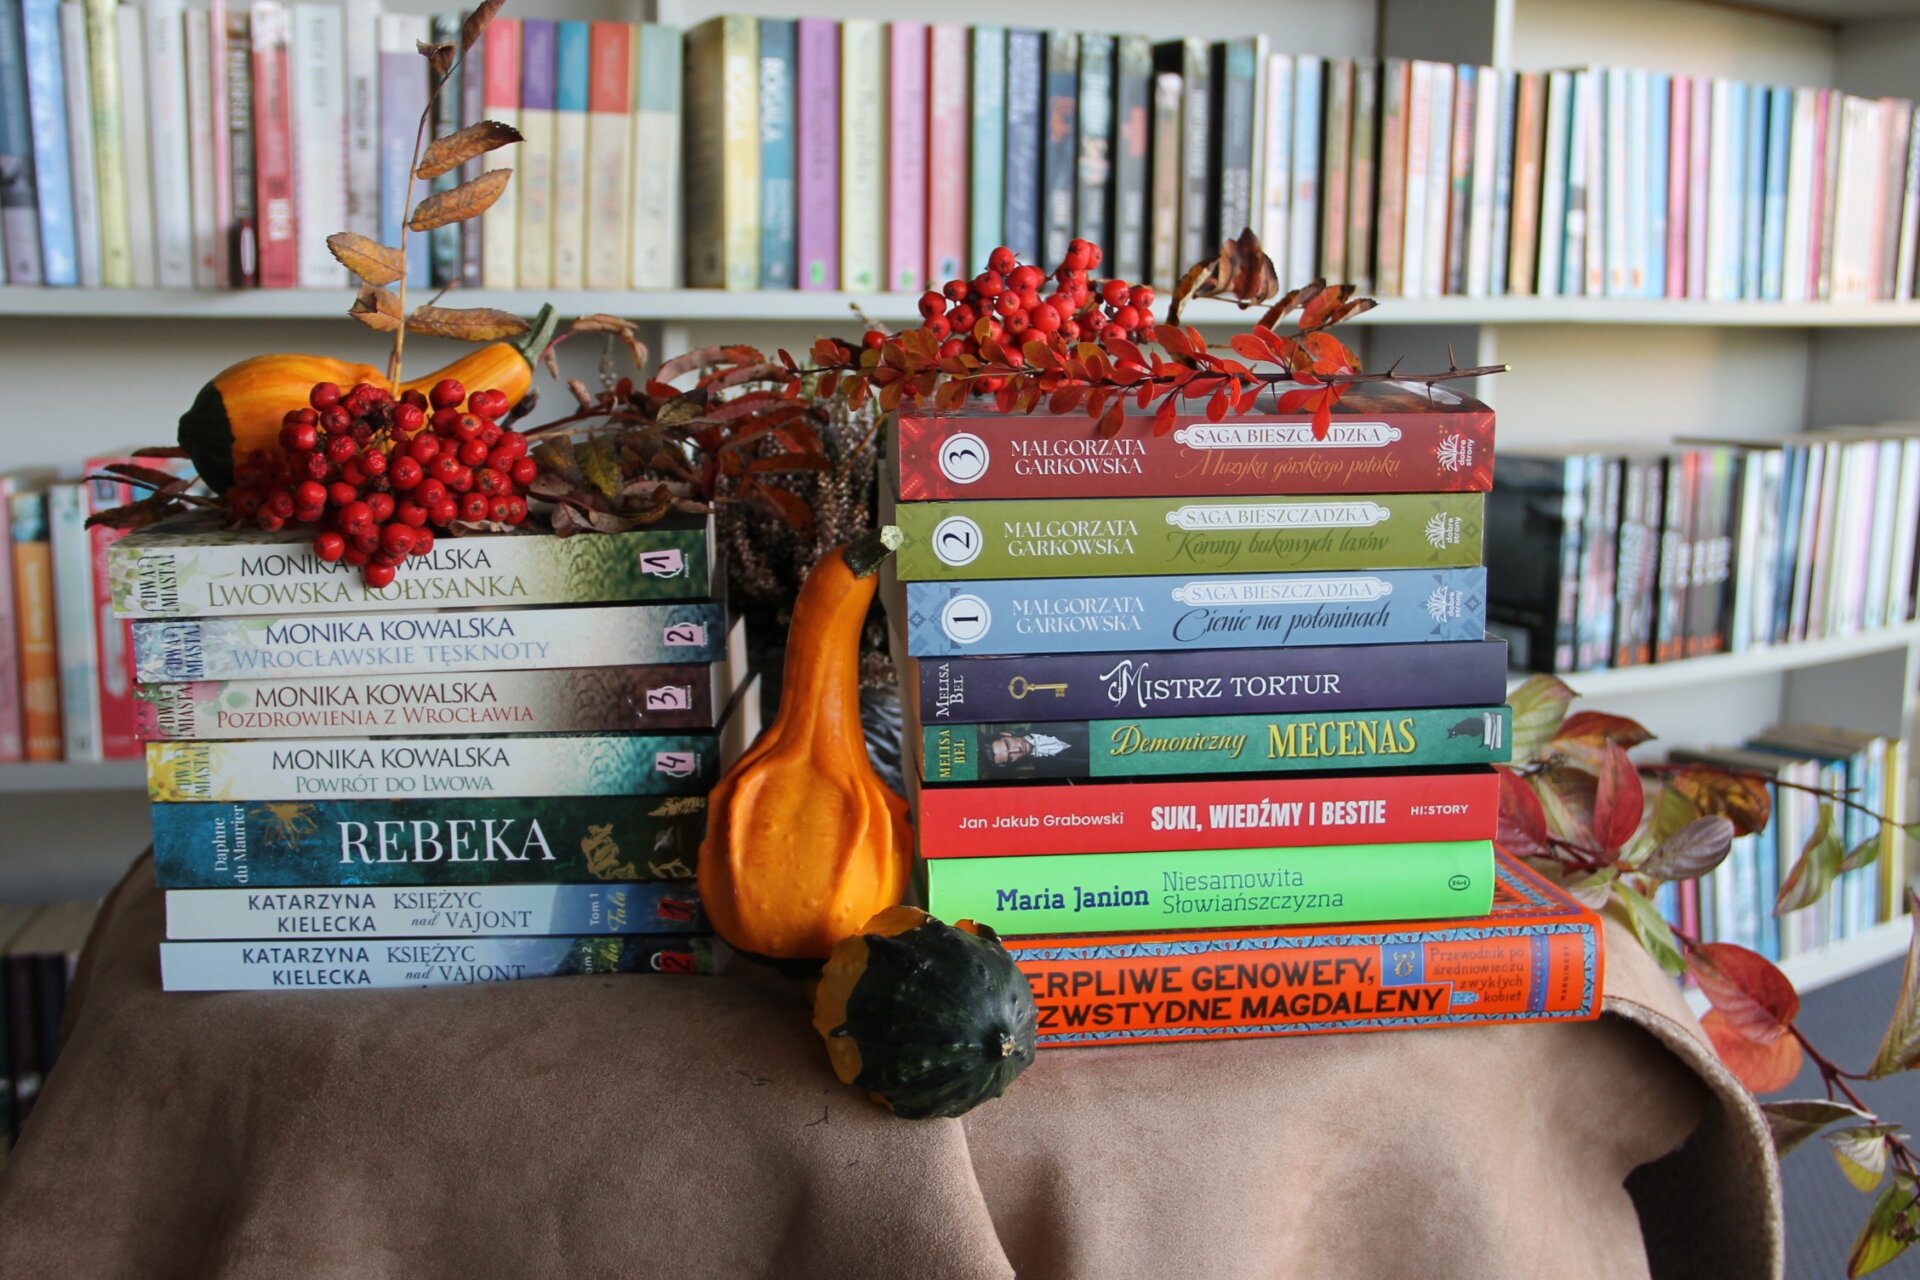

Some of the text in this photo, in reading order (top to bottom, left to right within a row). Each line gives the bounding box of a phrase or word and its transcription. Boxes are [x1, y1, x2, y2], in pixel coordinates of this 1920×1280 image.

[1194, 429, 1242, 444] SAGA
[949, 448, 982, 466] 3
[1457, 439, 1466, 466] dobre
[1466, 438, 1475, 467] strony
[1014, 457, 1143, 476] GARKOWSKA
[1175, 447, 1401, 486] Muzyka górskiego potoku
[1186, 507, 1370, 525] SAGA BIESZCZADZKA
[941, 531, 970, 550] 2
[1444, 517, 1454, 544] dobre
[1454, 516, 1463, 544] strony
[1007, 538, 1135, 557] GARKOWSKA
[1166, 527, 1389, 567] Korony bukowych lasów
[241, 548, 492, 577] MONIKA WALSKA
[643, 555, 670, 570] 1
[139, 570, 158, 598] DWA
[158, 560, 179, 607] MIASTA
[206, 580, 352, 607] LWOWSKA
[1191, 583, 1373, 601] SAGA BIESZCZADZKA
[266, 617, 515, 645] MONIKA KOWALSKA
[952, 615, 979, 623] 1
[1016, 615, 1142, 634] GARKOWSKA
[1172, 601, 1392, 644] Cienie na połoninach
[666, 630, 695, 642] 2
[164, 638, 183, 665] DWA
[183, 630, 204, 673] MIASTA
[233, 641, 550, 670] WROCŁAWSKIE TĘSKNOTY
[255, 682, 498, 708] MONIKA KOWALSKA
[935, 662, 950, 717] MELISA
[949, 674, 964, 705] BEL
[1099, 659, 1341, 708] MISTRZ TORTUR
[157, 695, 175, 724] DWA
[176, 686, 195, 733] MIASTA
[648, 692, 678, 706] 3
[217, 705, 536, 729] POZDROWIENIA Z WROCŁAWIA
[1109, 717, 1417, 759] Demoniczny MECENAS
[272, 747, 511, 770] MONIKA KOWALSKA
[657, 755, 687, 769] 4
[939, 729, 951, 778] MELISA
[954, 739, 966, 764] BEL
[175, 759, 192, 786] DWA
[193, 750, 211, 795] MIASTA
[296, 773, 495, 793] POWRÓT DO LWOWA
[959, 811, 1124, 829] Jan Jakub Grabowski
[1151, 797, 1386, 832] SUKI, WIEDŹMY I BESTIE
[1410, 804, 1469, 816] HI:STORY
[212, 816, 229, 872] Daphne
[230, 804, 249, 884] du Maurier
[336, 818, 557, 865] REBEKA
[1163, 868, 1304, 892] Niesamowita
[248, 893, 376, 911] KATARZYNA
[393, 889, 482, 913] KSIĘŻYC
[996, 885, 1150, 912] Maria Janion
[1162, 892, 1344, 915] Słowiańszczyzna
[278, 915, 377, 933] KIELECKA
[411, 910, 532, 933] nad VAJONT
[590, 901, 600, 926] Tom
[607, 891, 627, 932] Fala
[243, 946, 370, 965] KATARZYNA
[387, 942, 476, 967] KSIĘŻYC
[584, 956, 593, 974] om
[662, 955, 691, 970] 2
[1429, 945, 1524, 962] Przewodnik po
[272, 968, 371, 986] KIELECKA
[405, 964, 526, 985] nad VAJONT
[1025, 956, 1375, 999] ERPLIWE GENOWEFY,
[1433, 962, 1524, 976] średniowieczu
[1460, 974, 1523, 991] zwykłych
[1037, 987, 1444, 1028] ZWSTYDNE MAGDALENY
[1483, 990, 1522, 1003] kobiet
